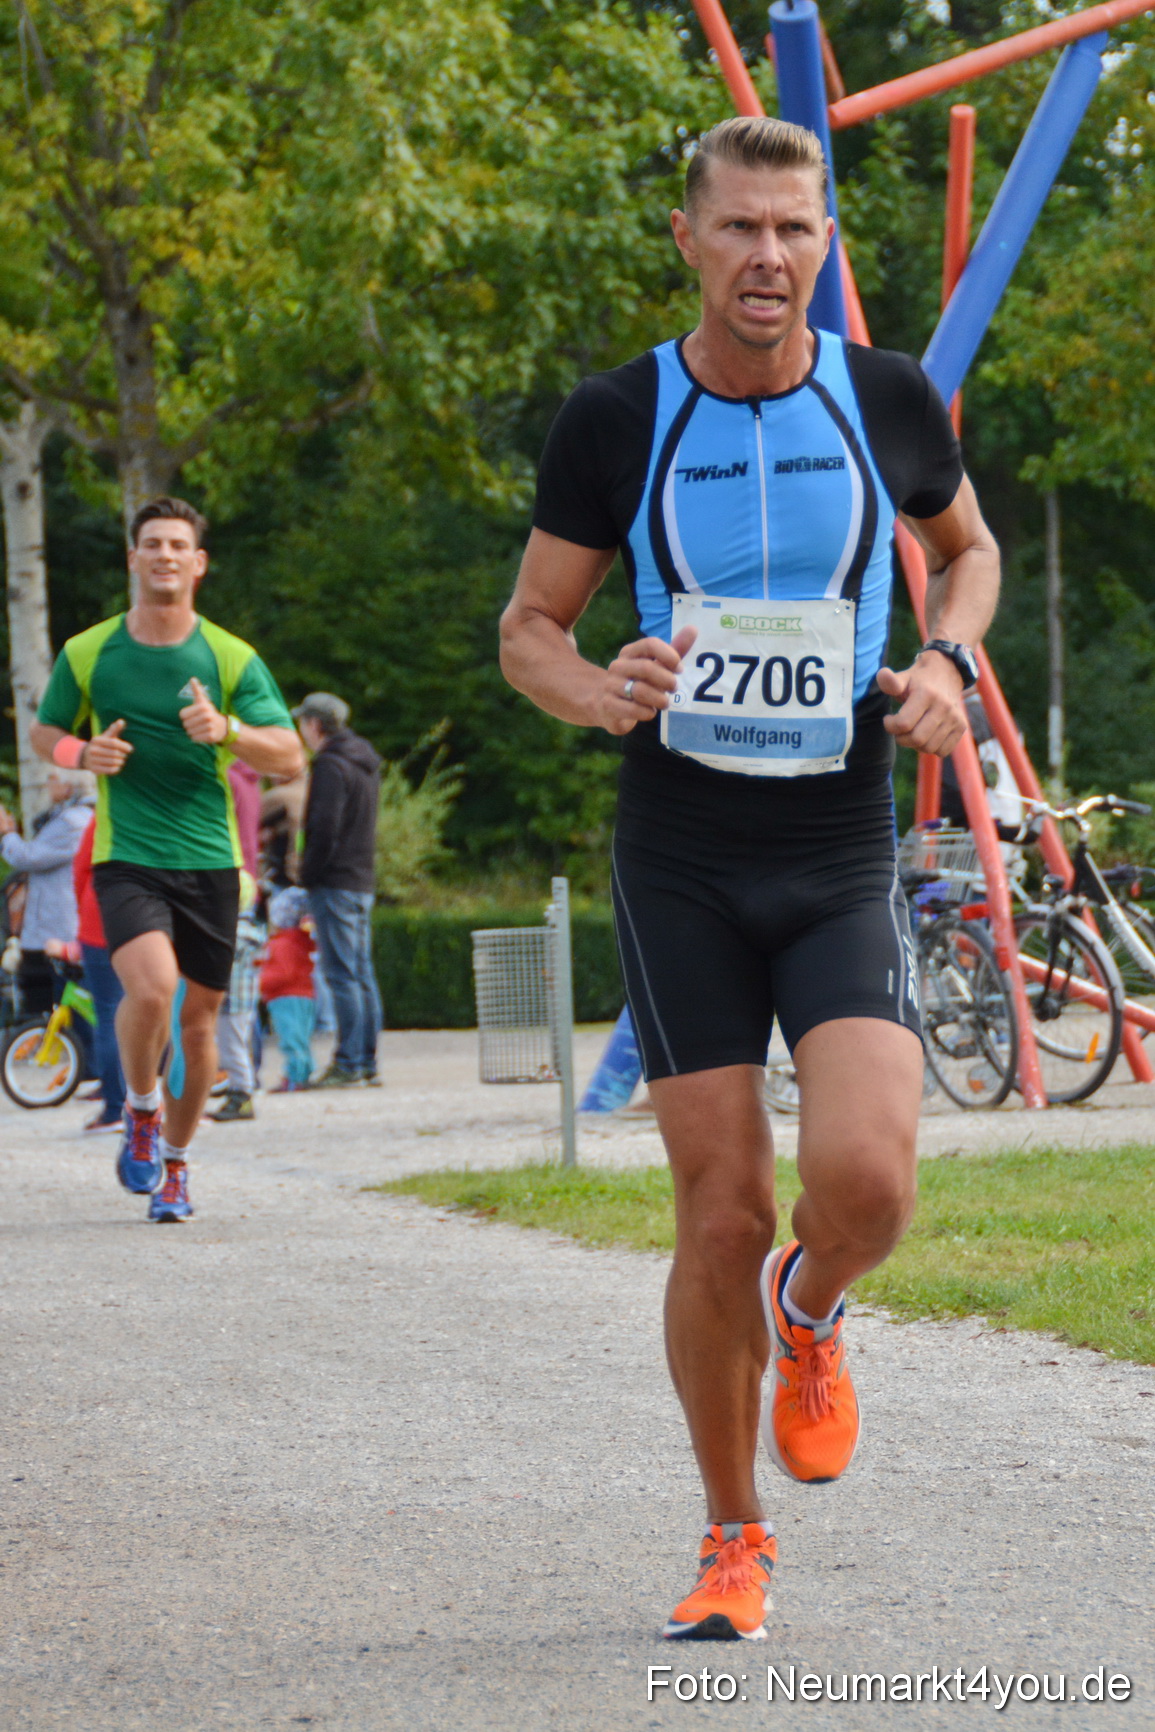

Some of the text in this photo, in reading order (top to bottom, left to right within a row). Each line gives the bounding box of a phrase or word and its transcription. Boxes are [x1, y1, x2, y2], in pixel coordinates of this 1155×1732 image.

[739, 615, 802, 632] BOCK
[693, 652, 826, 707] 2706
[674, 694, 681, 703] D
[714, 724, 802, 748] Wolfgang
